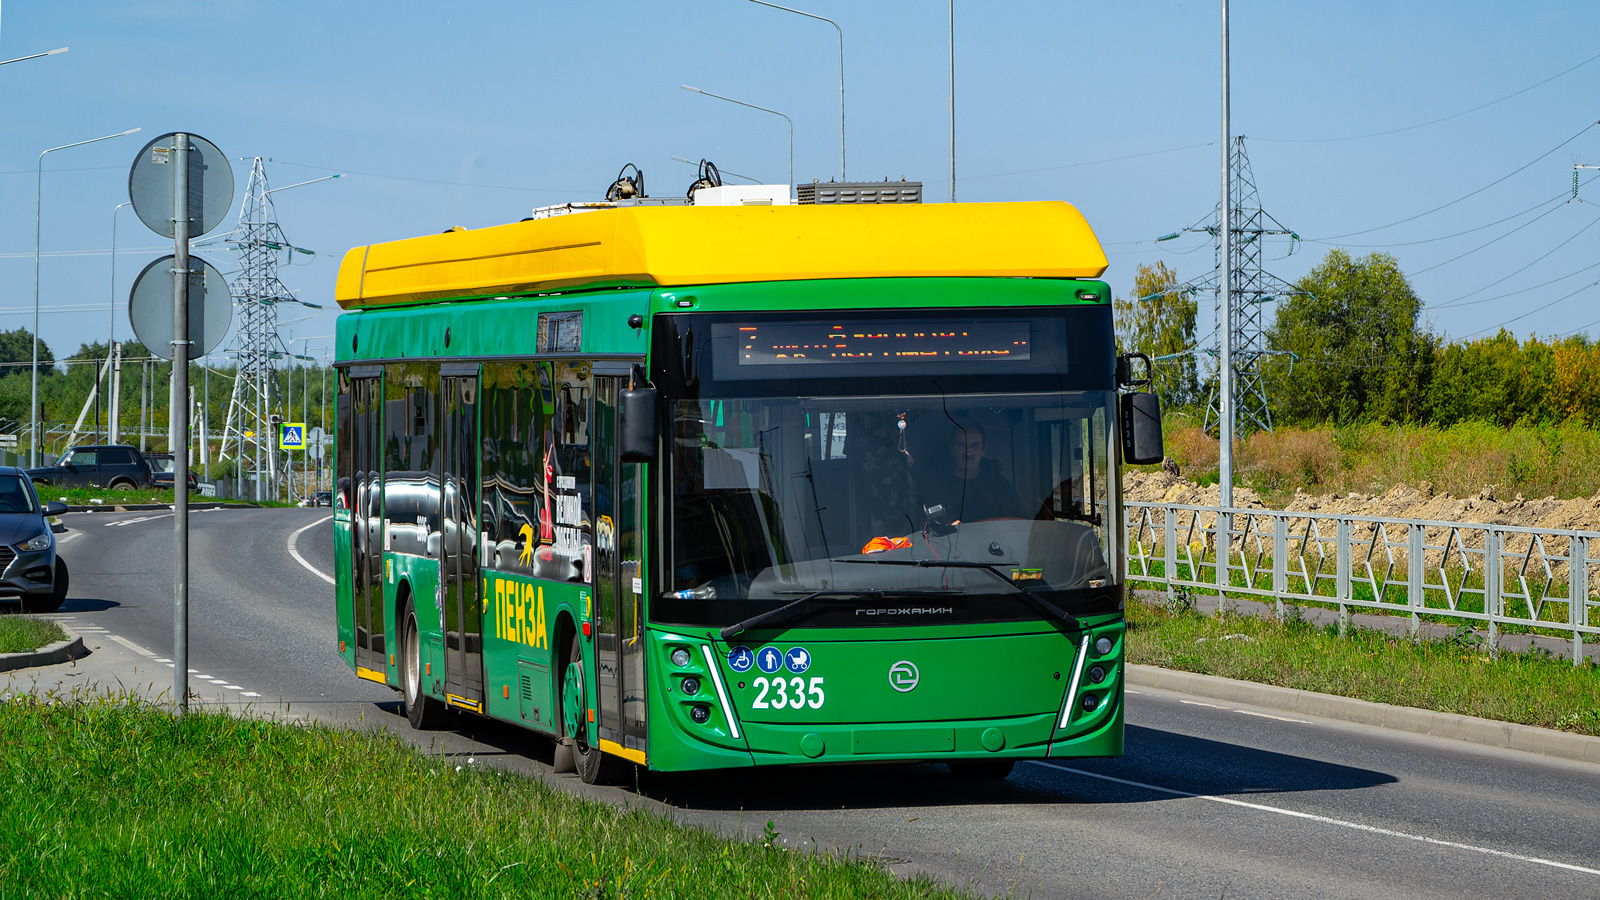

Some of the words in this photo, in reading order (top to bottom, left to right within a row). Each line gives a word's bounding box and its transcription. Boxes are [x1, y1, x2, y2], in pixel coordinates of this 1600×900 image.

[495, 578, 548, 650] ПЕНЗА
[855, 607, 953, 616] ГОРОЖАНИН
[752, 676, 825, 709] 2335
